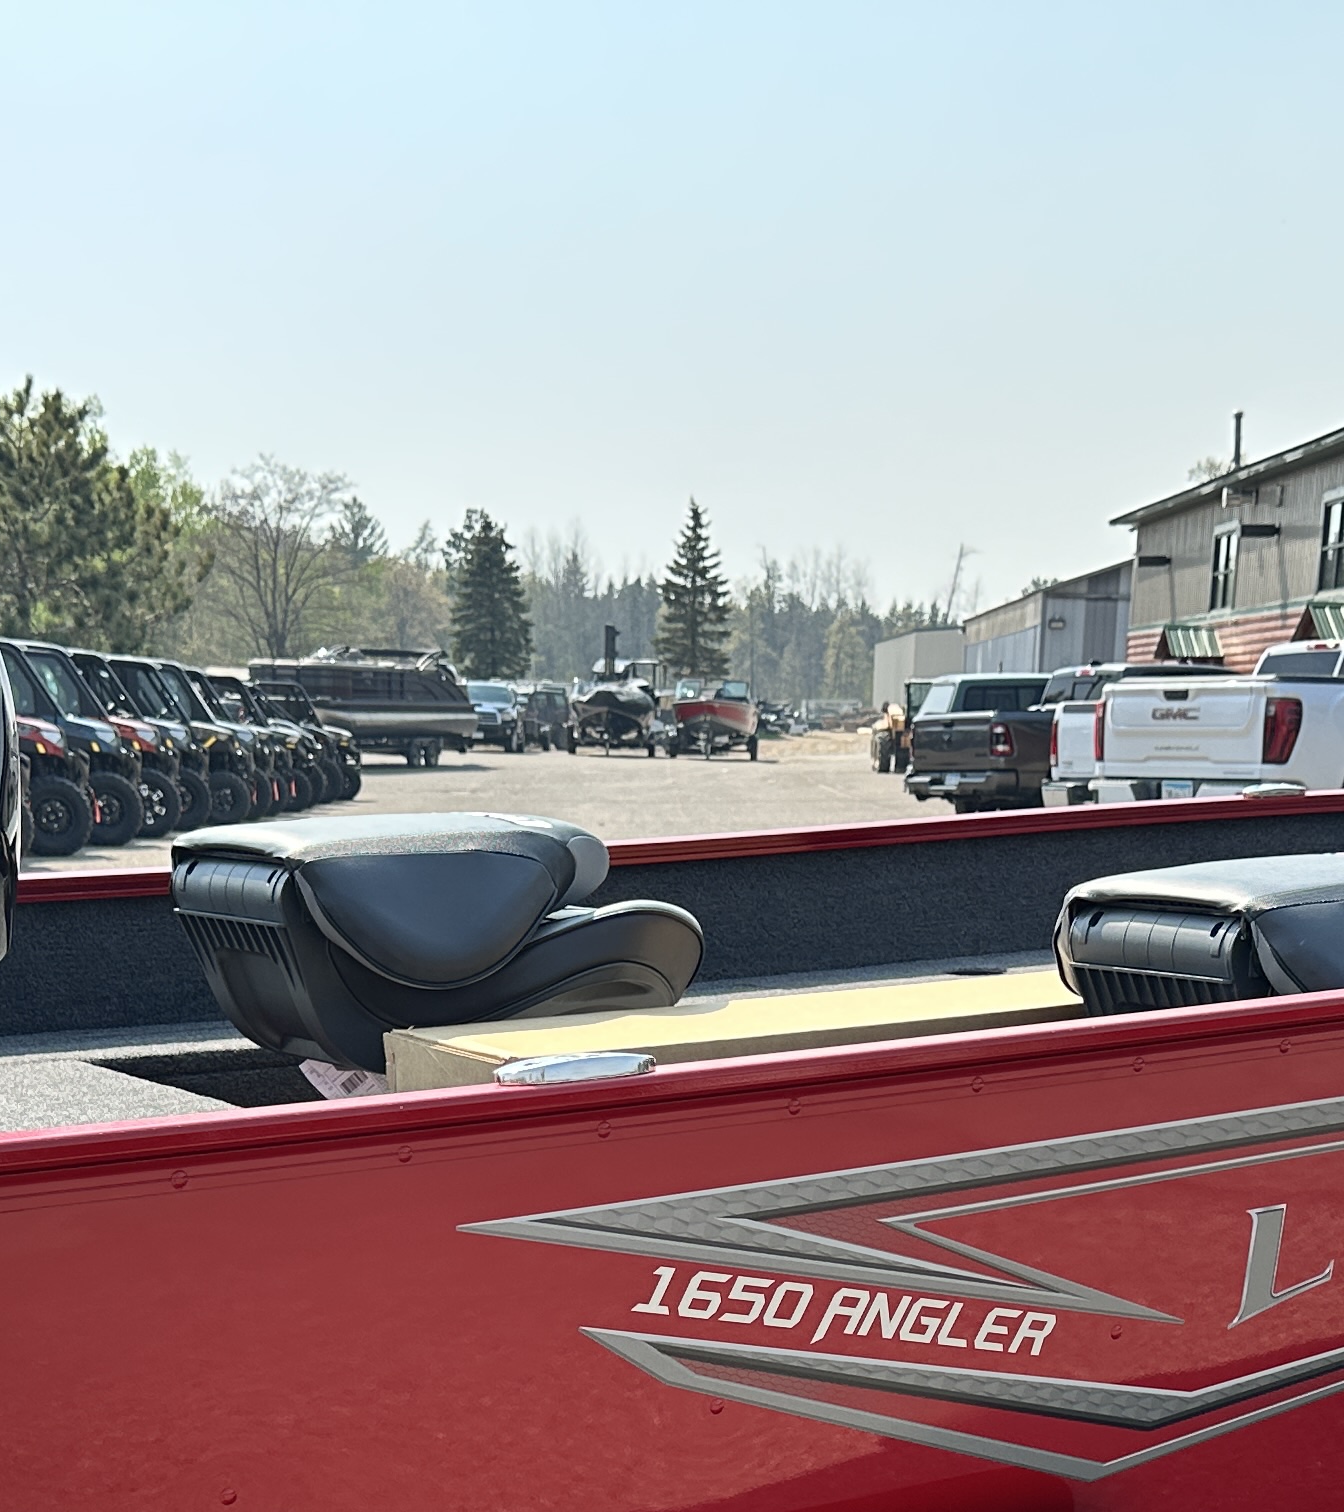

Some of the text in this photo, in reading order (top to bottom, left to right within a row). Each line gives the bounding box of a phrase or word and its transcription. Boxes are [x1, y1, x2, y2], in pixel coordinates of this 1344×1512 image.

[1151, 707, 1201, 721] GMC
[631, 1266, 1058, 1356] 1650 ANGLER
